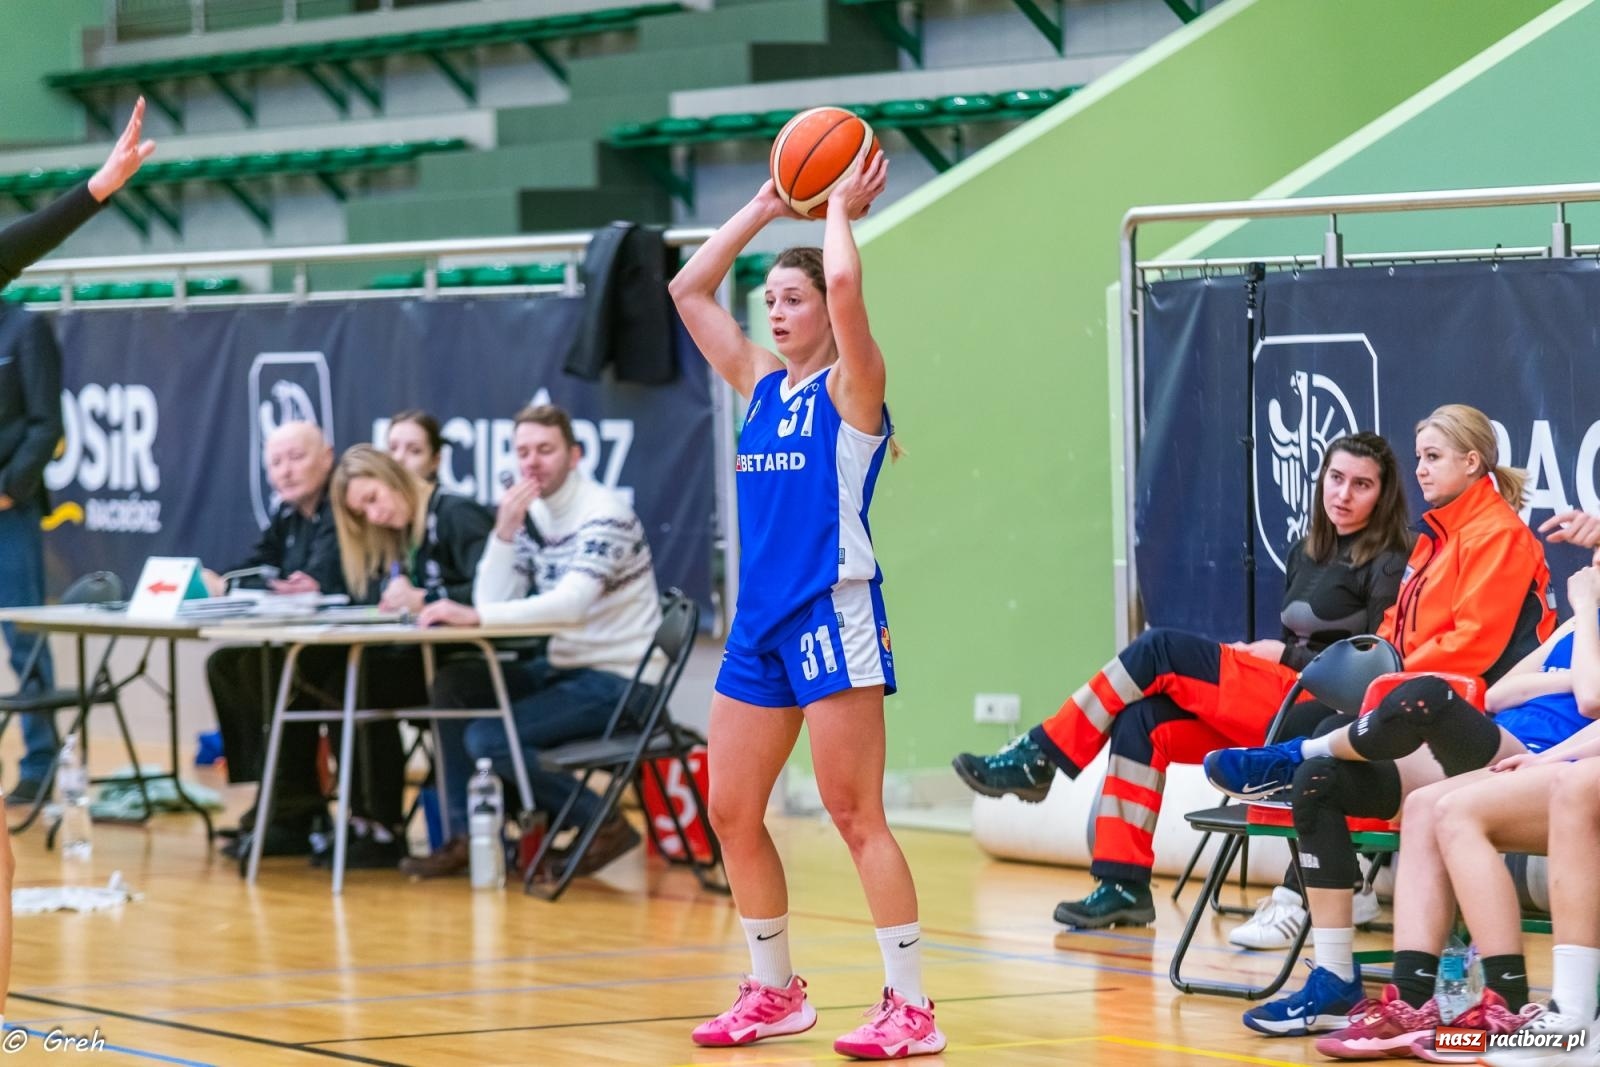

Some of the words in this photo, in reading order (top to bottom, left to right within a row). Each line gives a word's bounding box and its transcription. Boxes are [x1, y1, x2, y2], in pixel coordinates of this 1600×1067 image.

[777, 394, 816, 438] 31
[741, 451, 806, 472] BETARD
[801, 624, 838, 681] 31
